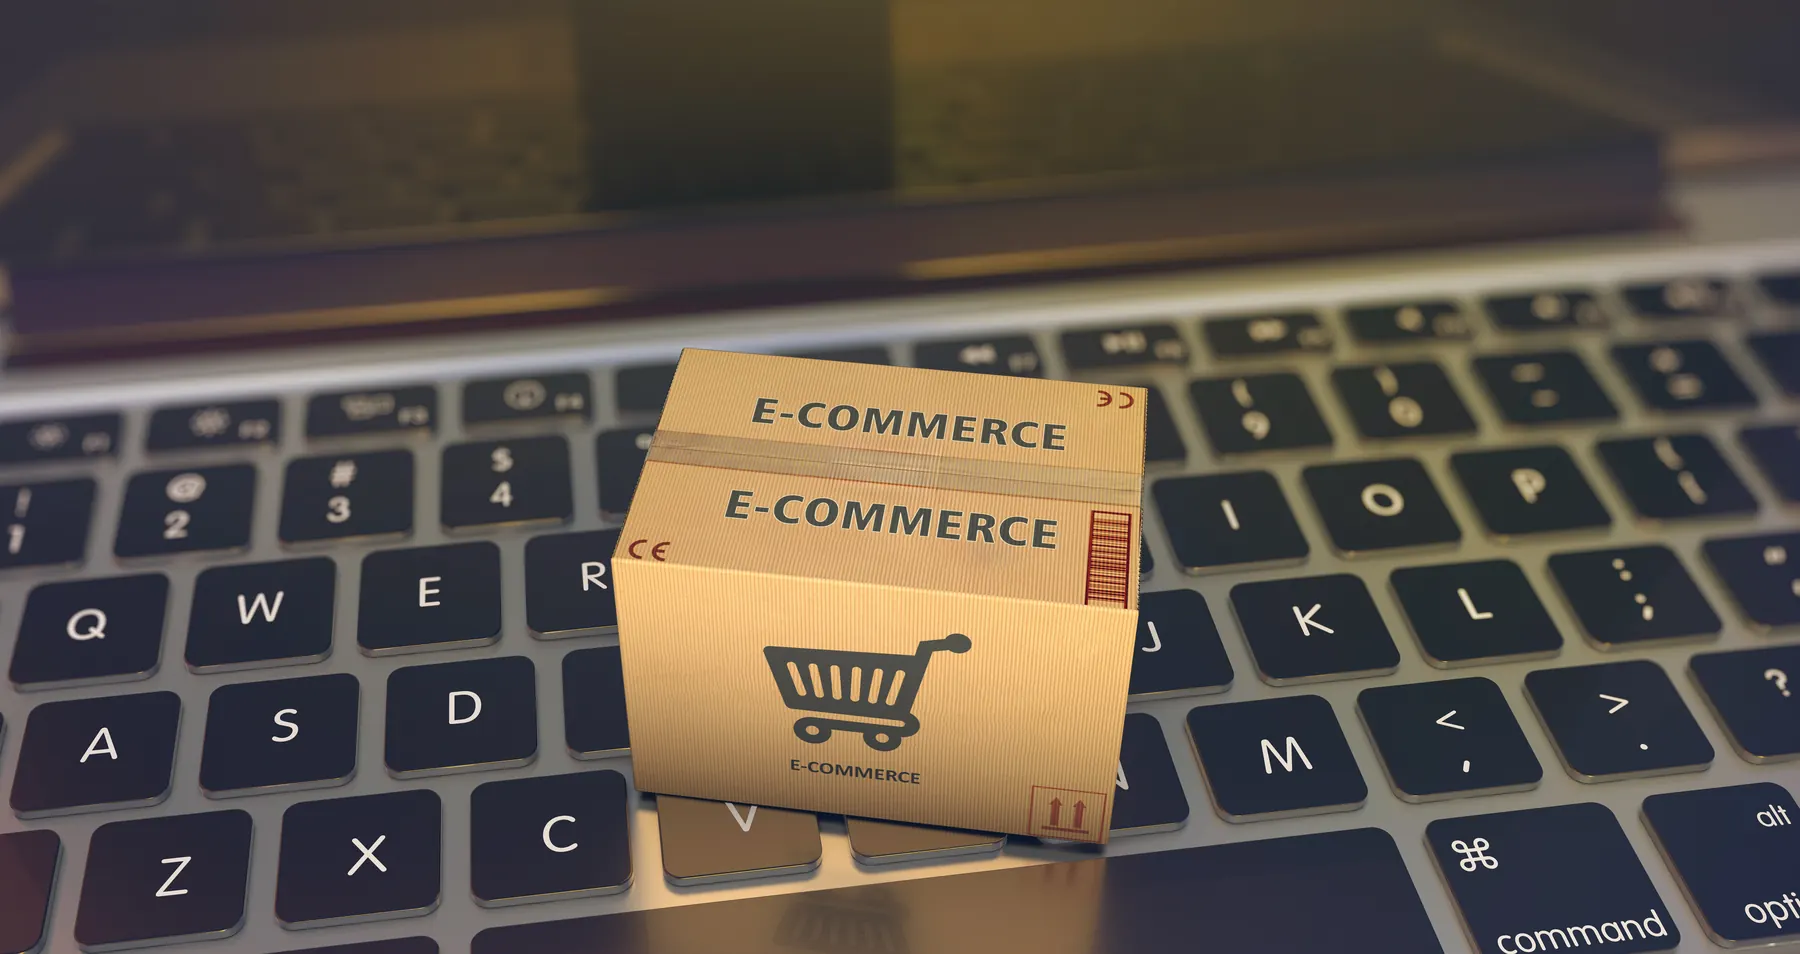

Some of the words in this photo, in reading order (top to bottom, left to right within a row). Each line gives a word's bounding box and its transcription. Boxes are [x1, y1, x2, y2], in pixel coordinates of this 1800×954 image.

[752, 397, 1067, 452] E-COMMERCE
[492, 483, 511, 506] 4
[1362, 485, 1403, 515] O
[1511, 468, 1546, 504] P
[166, 512, 188, 538] 2
[328, 497, 350, 522] 3
[725, 489, 1058, 550] E-COMMERCE
[628, 540, 671, 563] CE
[582, 560, 609, 591] R
[420, 577, 440, 607] E
[1458, 589, 1492, 619] L
[238, 592, 283, 624] W
[1293, 604, 1334, 636] K
[67, 609, 106, 640] Q
[1142, 622, 1161, 652] J
[1765, 670, 1789, 696] ?
[449, 691, 481, 724] D
[272, 709, 298, 742] S
[80, 728, 117, 762] A
[1261, 737, 1312, 774] M
[790, 759, 921, 786] E-COMMERCE
[1757, 800, 1796, 826] alt
[543, 816, 577, 852] C
[348, 835, 387, 875] X
[156, 857, 191, 897] Z
[1496, 908, 1668, 954] command
